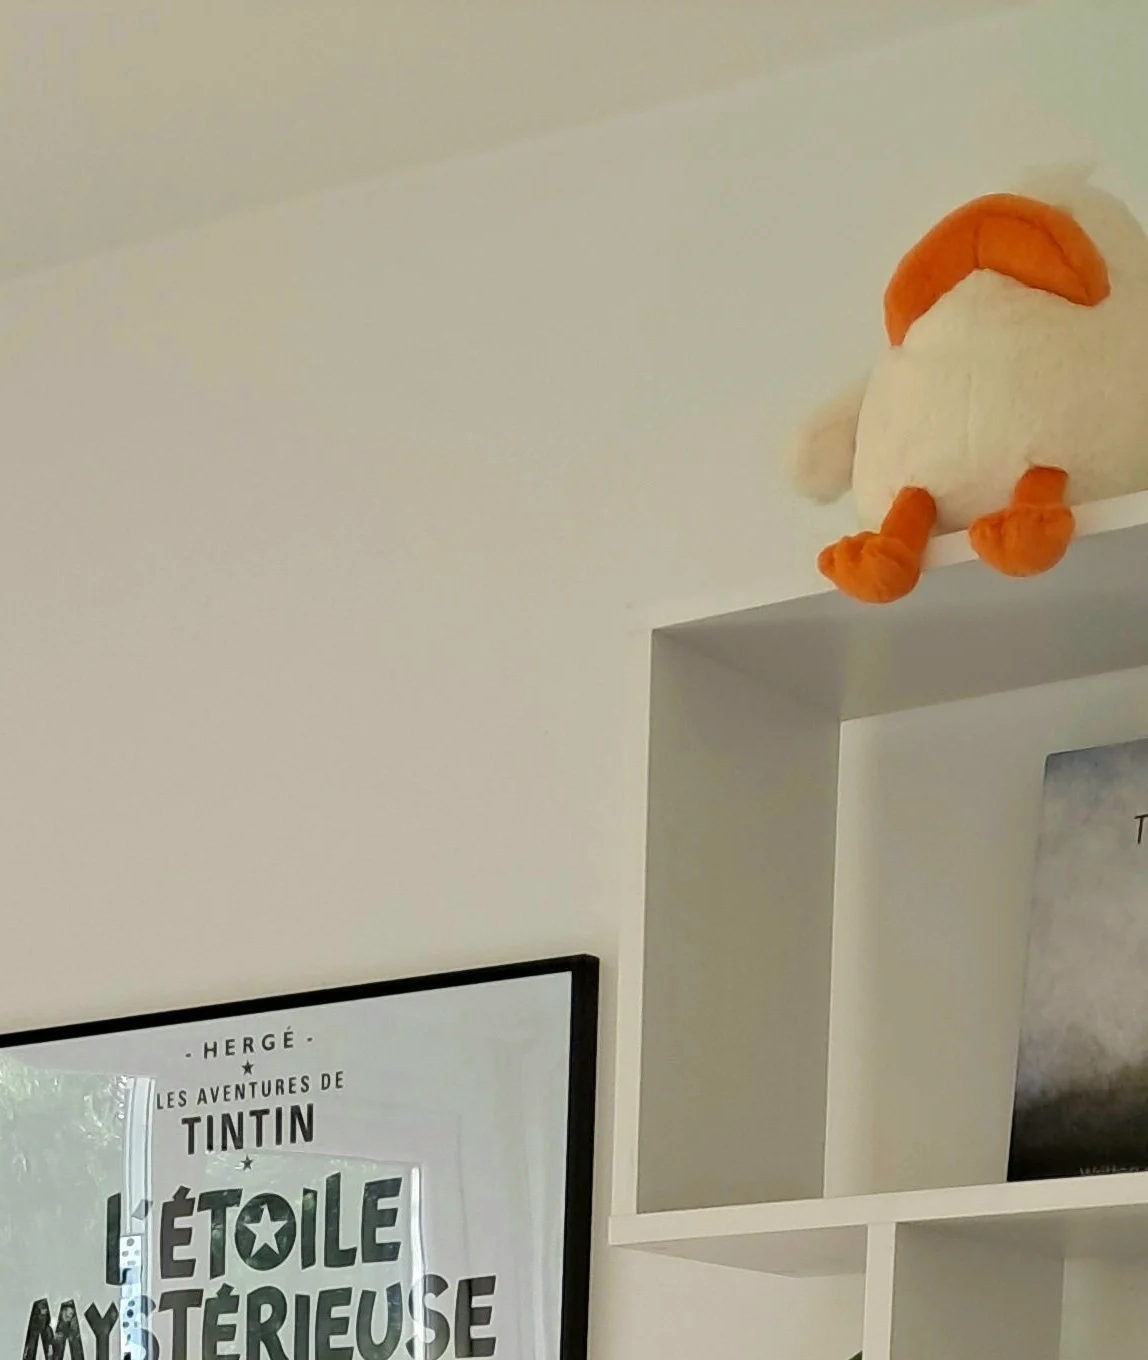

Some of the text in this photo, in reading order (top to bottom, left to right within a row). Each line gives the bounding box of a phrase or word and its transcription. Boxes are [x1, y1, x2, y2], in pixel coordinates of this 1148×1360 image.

[204, 1026, 294, 1059] HERGÉ
[157, 1071, 344, 1109] LES AVENTURES DE
[181, 1103, 314, 1155] TINTIN
[106, 1172, 403, 1285] L'ÉTOILE
